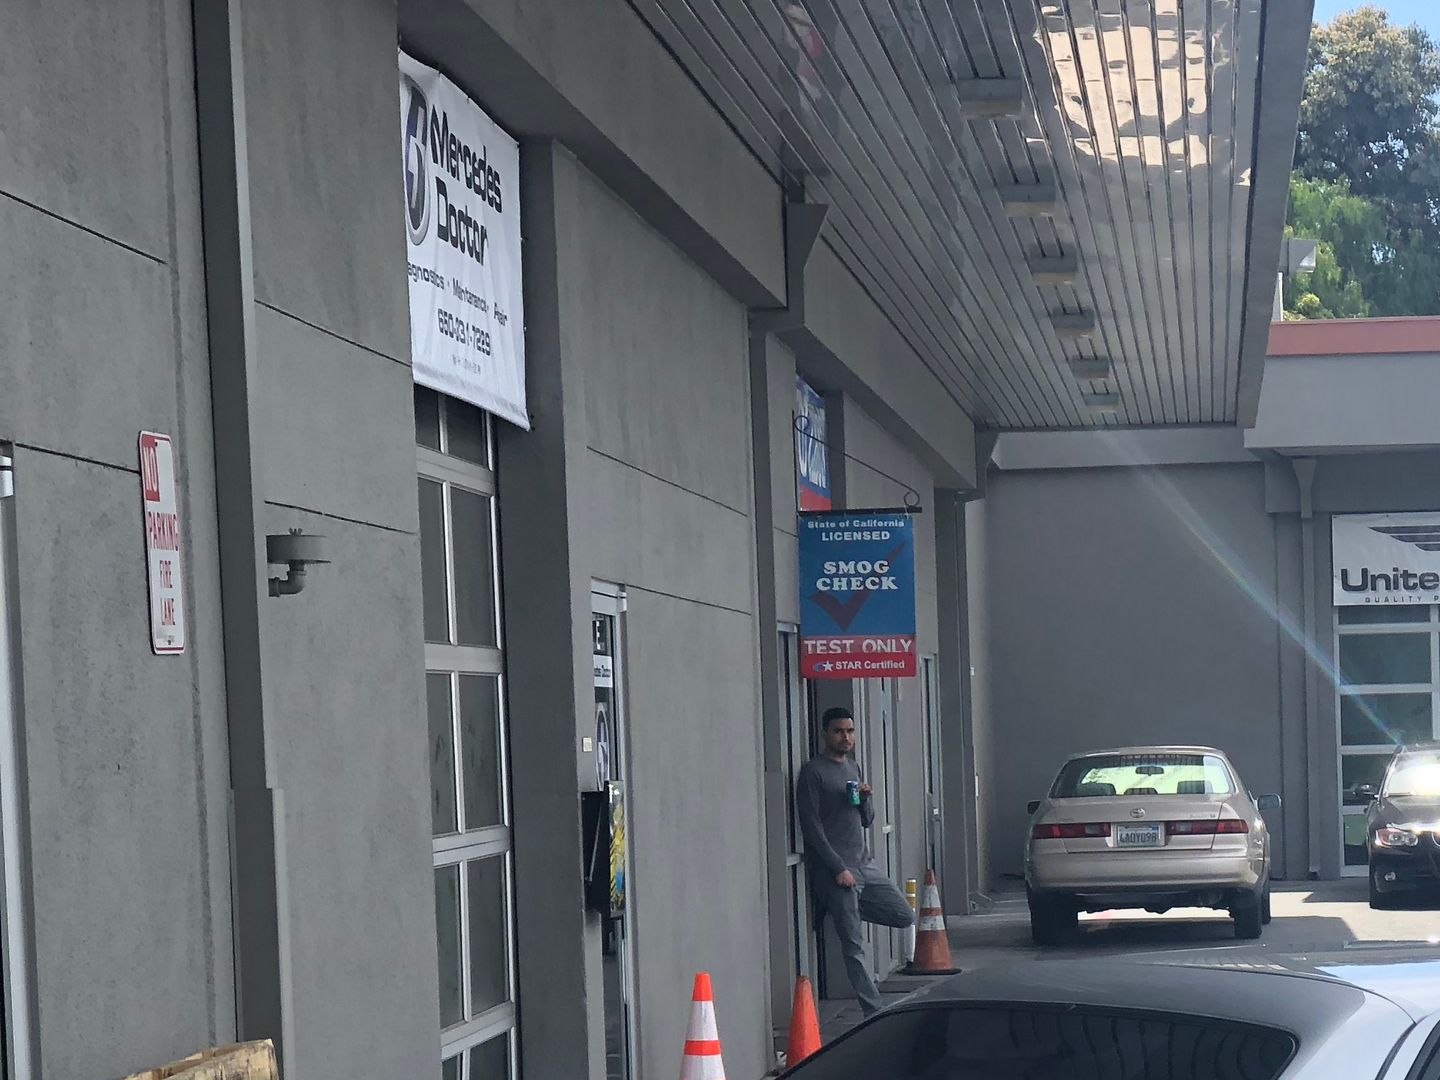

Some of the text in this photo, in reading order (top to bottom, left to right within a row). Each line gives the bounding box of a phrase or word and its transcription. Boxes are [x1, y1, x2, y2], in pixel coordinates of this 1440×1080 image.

[430, 104, 503, 214] Mercedes
[435, 176, 489, 266] Doctor
[142, 446, 158, 492] NO
[148, 511, 180, 551] PARKING
[807, 519, 905, 529] State of California
[821, 531, 890, 541] LICENSED
[159, 559, 173, 589] FIRE
[823, 560, 890, 575] SMOG
[816, 576, 899, 591] CHECK
[1364, 595, 1423, 604] QUALITY
[160, 597, 176, 626] LANE
[803, 639, 913, 655] TEST ONLY
[835, 660, 905, 670] STAR Certified
